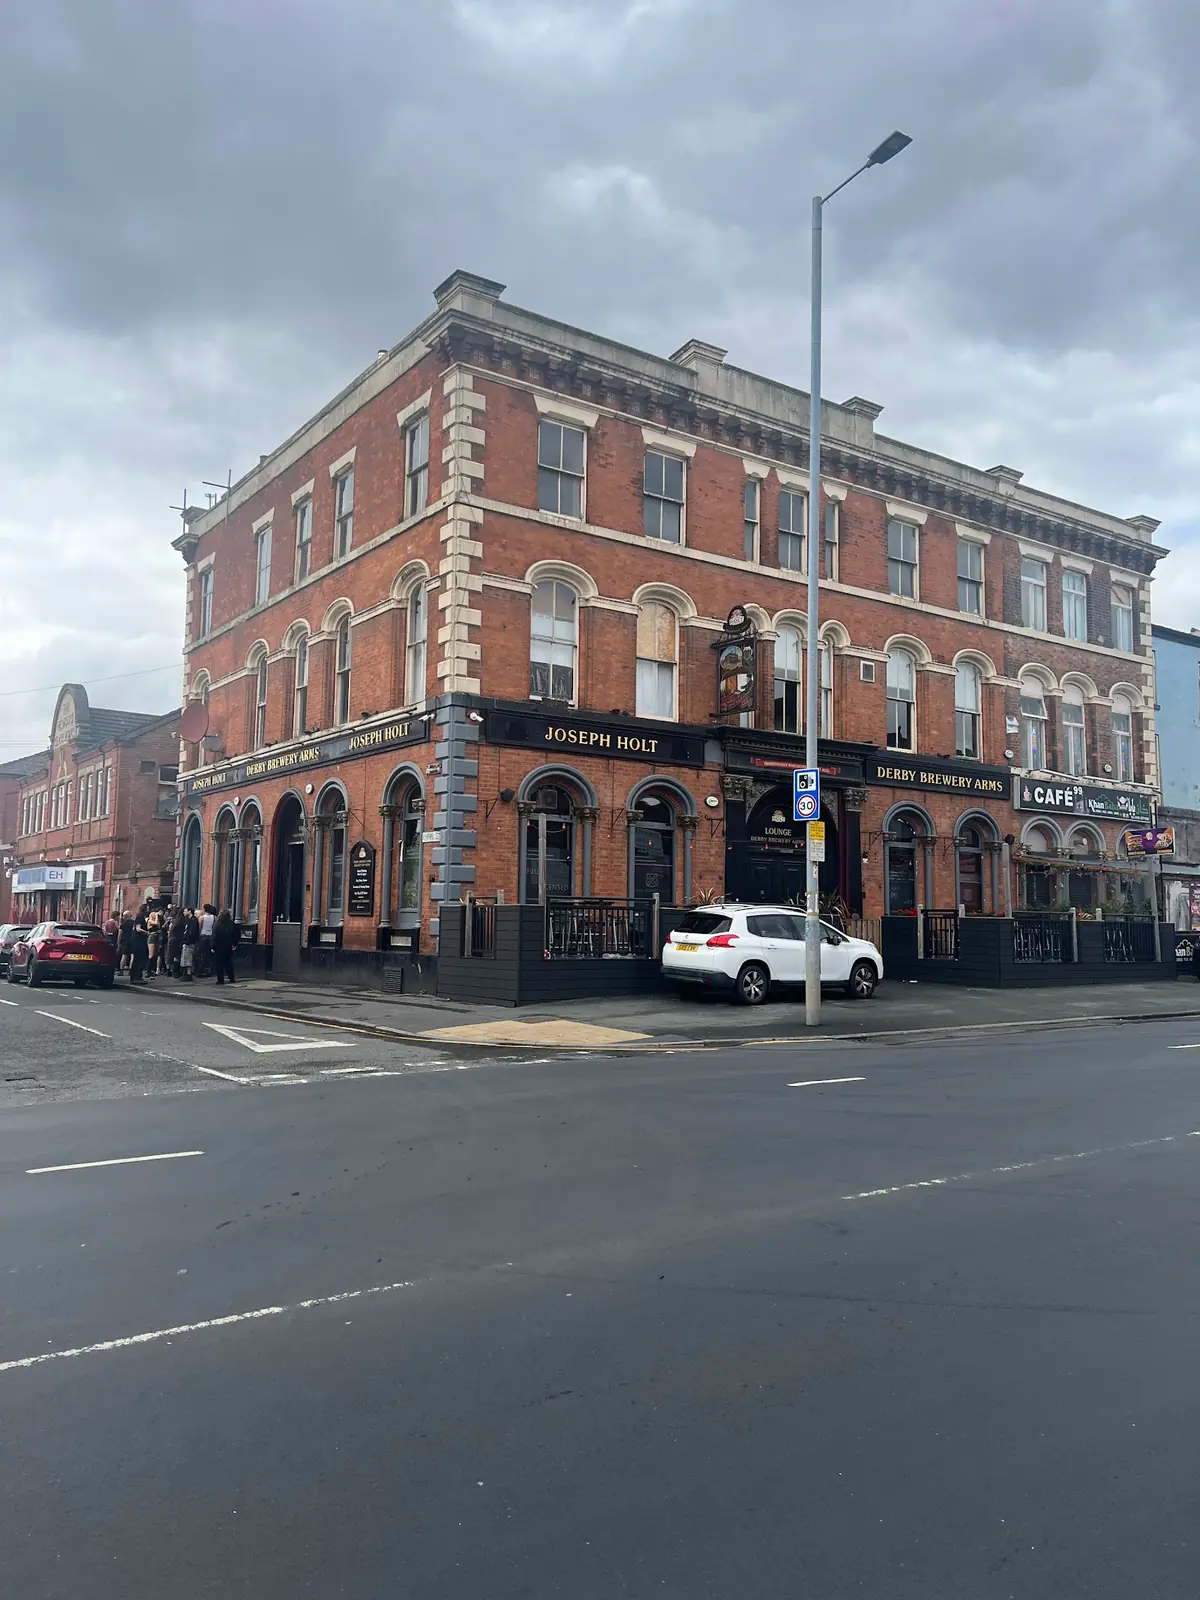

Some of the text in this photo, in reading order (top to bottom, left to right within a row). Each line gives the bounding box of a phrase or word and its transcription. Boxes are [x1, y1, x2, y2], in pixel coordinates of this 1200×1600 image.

[348, 722, 411, 750] JOSEPH HOLT
[544, 726, 659, 753] JOSEPH HOLT
[246, 746, 321, 776] DERBY BREWERY ARMS
[192, 772, 227, 790] JOSEPH HOLT
[877, 766, 1003, 792] DERBY BREWERY ARMS
[800, 801, 813, 811] 30
[1034, 785, 1083, 807] CAFÉ 99
[1088, 798, 1105, 813] Khan
[765, 827, 792, 837] LOUNGE
